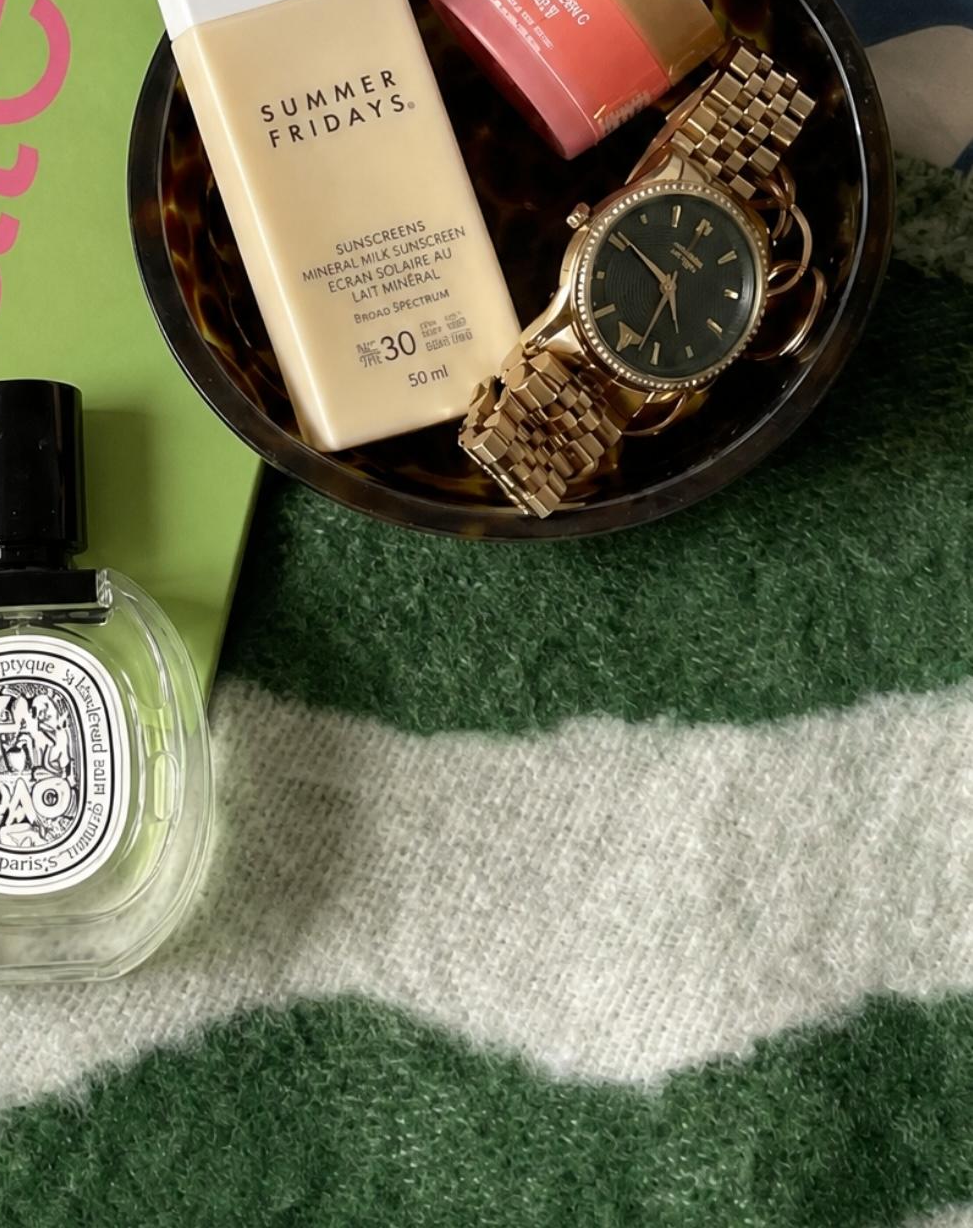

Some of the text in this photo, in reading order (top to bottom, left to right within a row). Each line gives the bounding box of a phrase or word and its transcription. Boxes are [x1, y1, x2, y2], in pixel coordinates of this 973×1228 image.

[260, 70, 397, 123] SUMMER
[302, 226, 467, 282] MINERAL MILK SUNSCREEN
[335, 220, 426, 256] SUNSCREENS
[328, 247, 453, 293] ECRAN SOLAIRE AU
[351, 285, 379, 304] LAIT
[379, 330, 417, 362] 30
[408, 364, 449, 388] 50 ml
